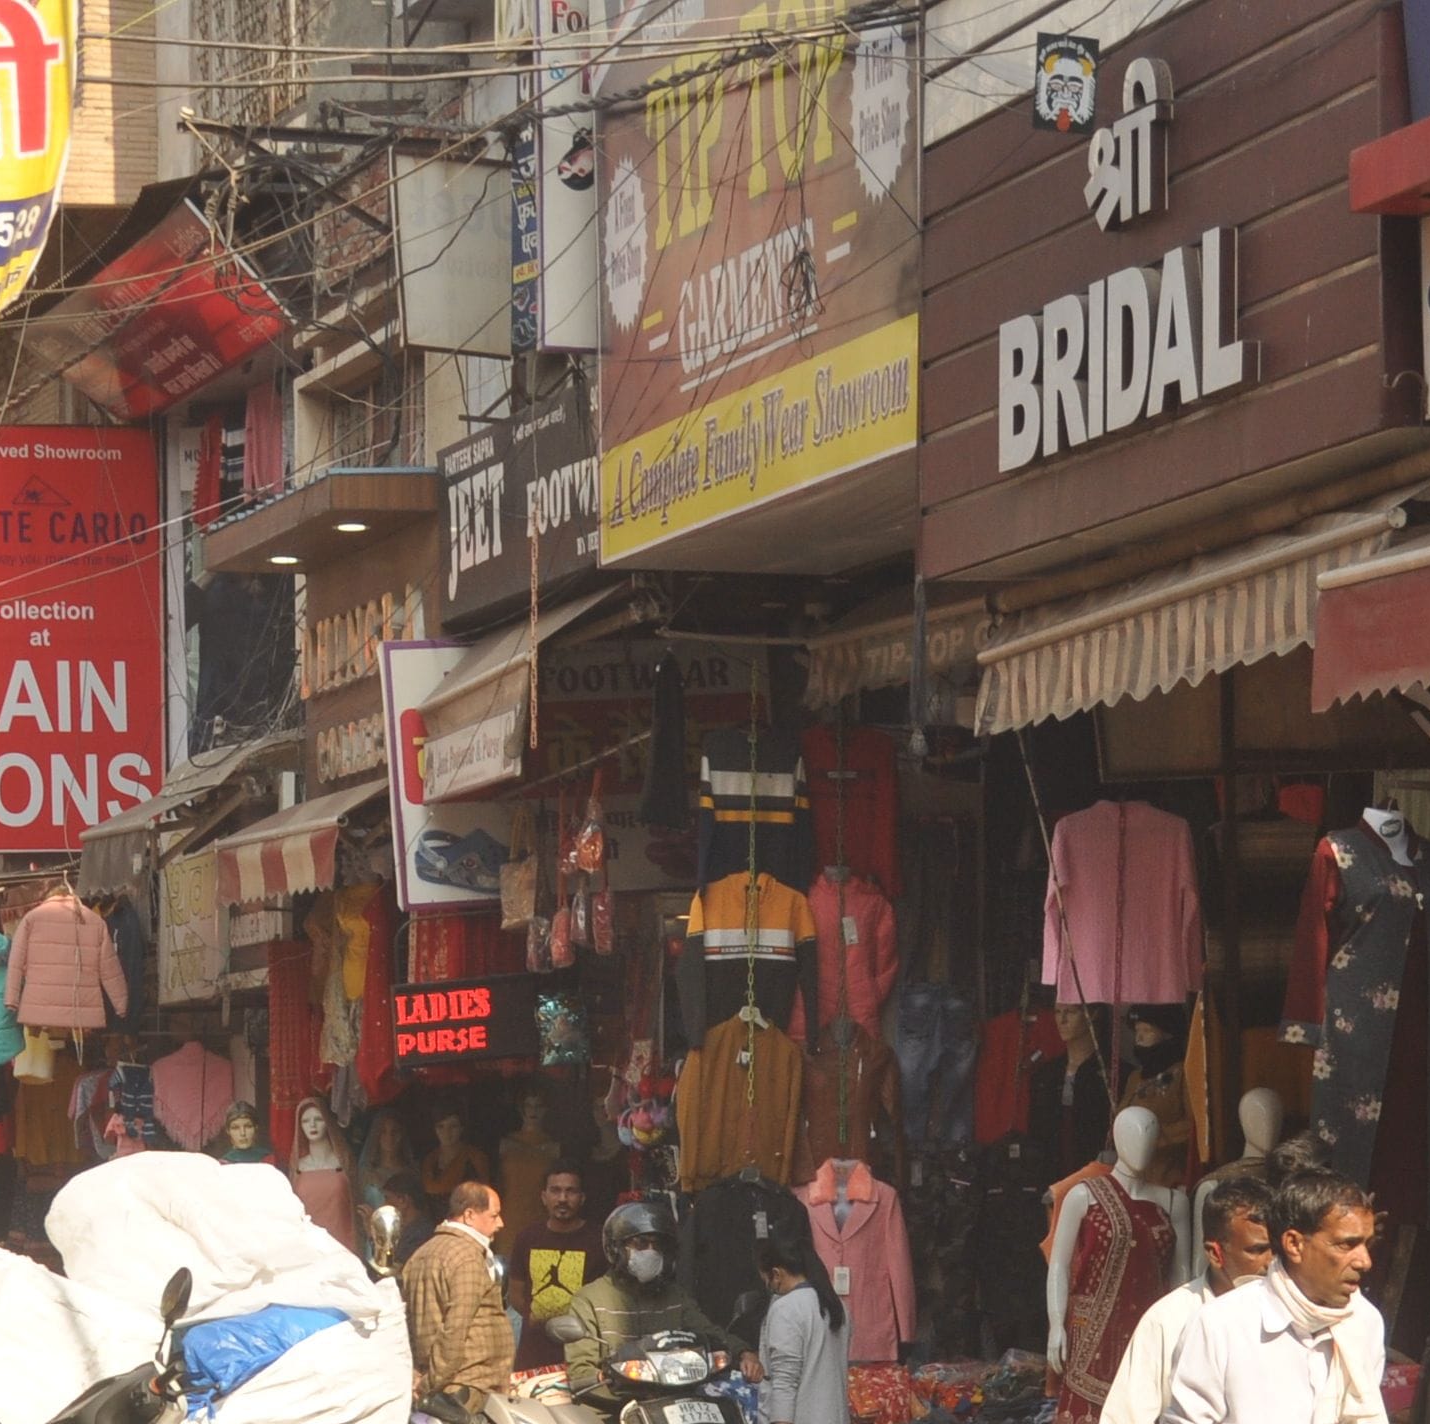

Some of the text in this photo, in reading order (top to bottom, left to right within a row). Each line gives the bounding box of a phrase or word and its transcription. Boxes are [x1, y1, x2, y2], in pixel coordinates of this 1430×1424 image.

[644, 45, 724, 250] TIP
[1083, 57, 1173, 233] श्री
[998, 227, 1245, 473] BRIDAL
[33, 443, 123, 462] Showroom
[609, 357, 911, 529] A Complete Family Wear Showroom
[49, 510, 149, 546] CARLO
[448, 461, 505, 602] JEET
[29, 628, 51, 648] at
[539, 655, 730, 695] FOOTWAR
[395, 987, 491, 1027] LADIES
[397, 1025, 487, 1057] PURSE
